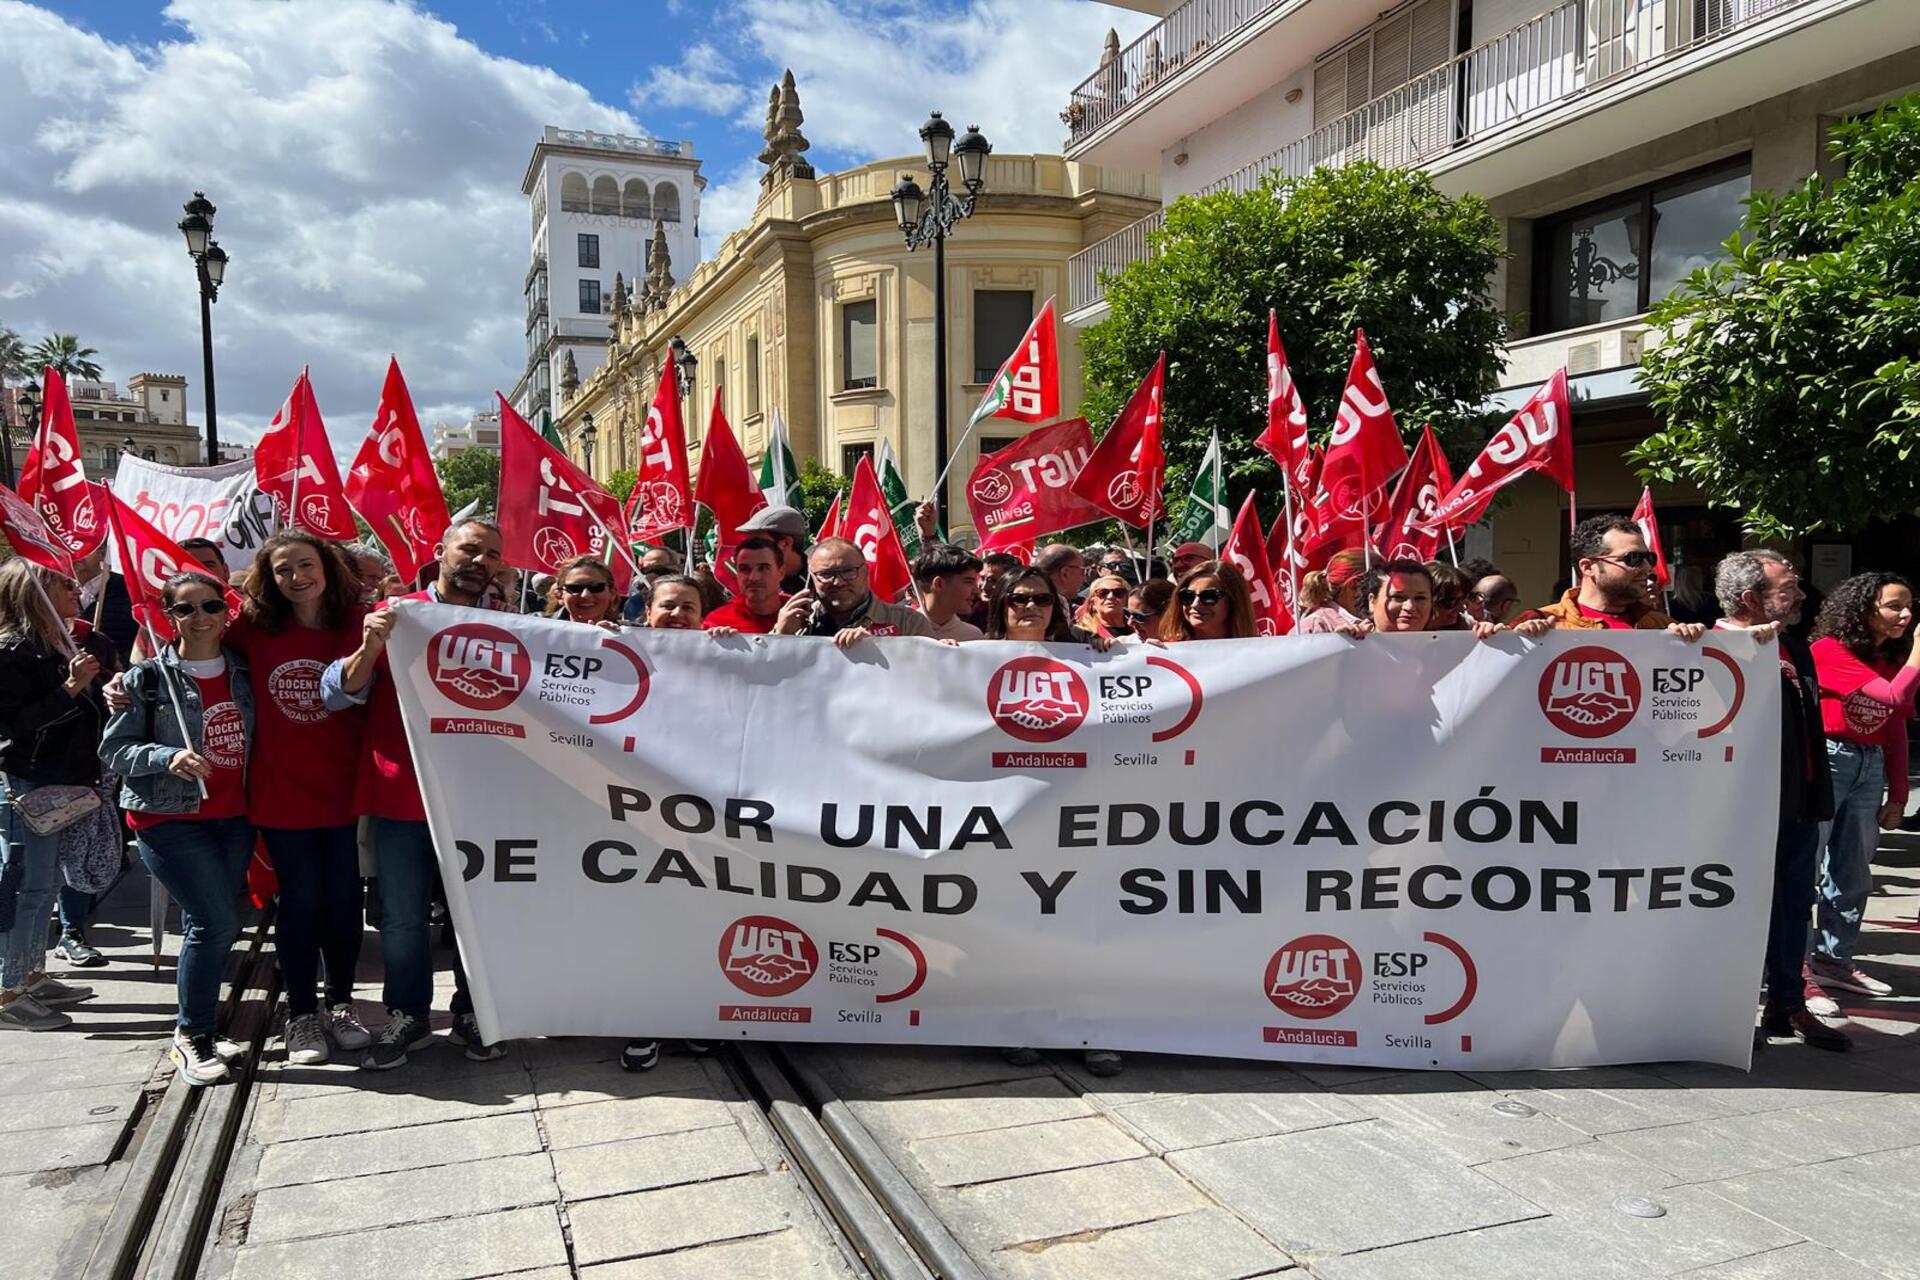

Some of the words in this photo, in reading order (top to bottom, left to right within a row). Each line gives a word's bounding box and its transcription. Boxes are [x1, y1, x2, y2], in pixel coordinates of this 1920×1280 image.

[439, 635, 518, 675] UGT
[278, 678, 319, 689] DOCENT
[542, 679, 596, 695] Servicios
[1000, 670, 1074, 704] UGT
[1552, 662, 1627, 698] UGT
[539, 691, 591, 706] Públicos
[1652, 697, 1701, 707] Servicios
[1101, 702, 1153, 711] Servicios
[1102, 712, 1151, 724] Públicos
[1652, 709, 1698, 720] Públicos
[208, 720, 245, 736] DOCENT
[445, 720, 515, 736] Andalucía
[209, 732, 245, 747] ESENCIA
[550, 732, 594, 747] Sevilla
[1005, 753, 1075, 767] Andalucía
[1114, 753, 1158, 765] Sevilla
[1554, 749, 1625, 762] Andalucía
[1662, 750, 1701, 761] Sevilla
[607, 784, 775, 842] POR
[820, 802, 1012, 850] UNA
[1057, 786, 1579, 848] EDUCACIÓN
[581, 840, 978, 915] CALIDAD
[1020, 871, 1077, 914] Y
[1119, 868, 1262, 914] SIN
[1304, 863, 1736, 913] RECORTES
[731, 925, 804, 958] UGT
[829, 963, 879, 976] Servicios
[1277, 949, 1349, 983] UGT
[829, 973, 875, 986] Públicos
[1373, 980, 1425, 992] Servicios
[1374, 993, 1423, 1005] Públicos
[732, 1008, 800, 1021] Andalucía
[838, 1010, 882, 1023] Sevilla
[1276, 1030, 1345, 1045] Andalucía
[1385, 1034, 1431, 1048] Sevilla
